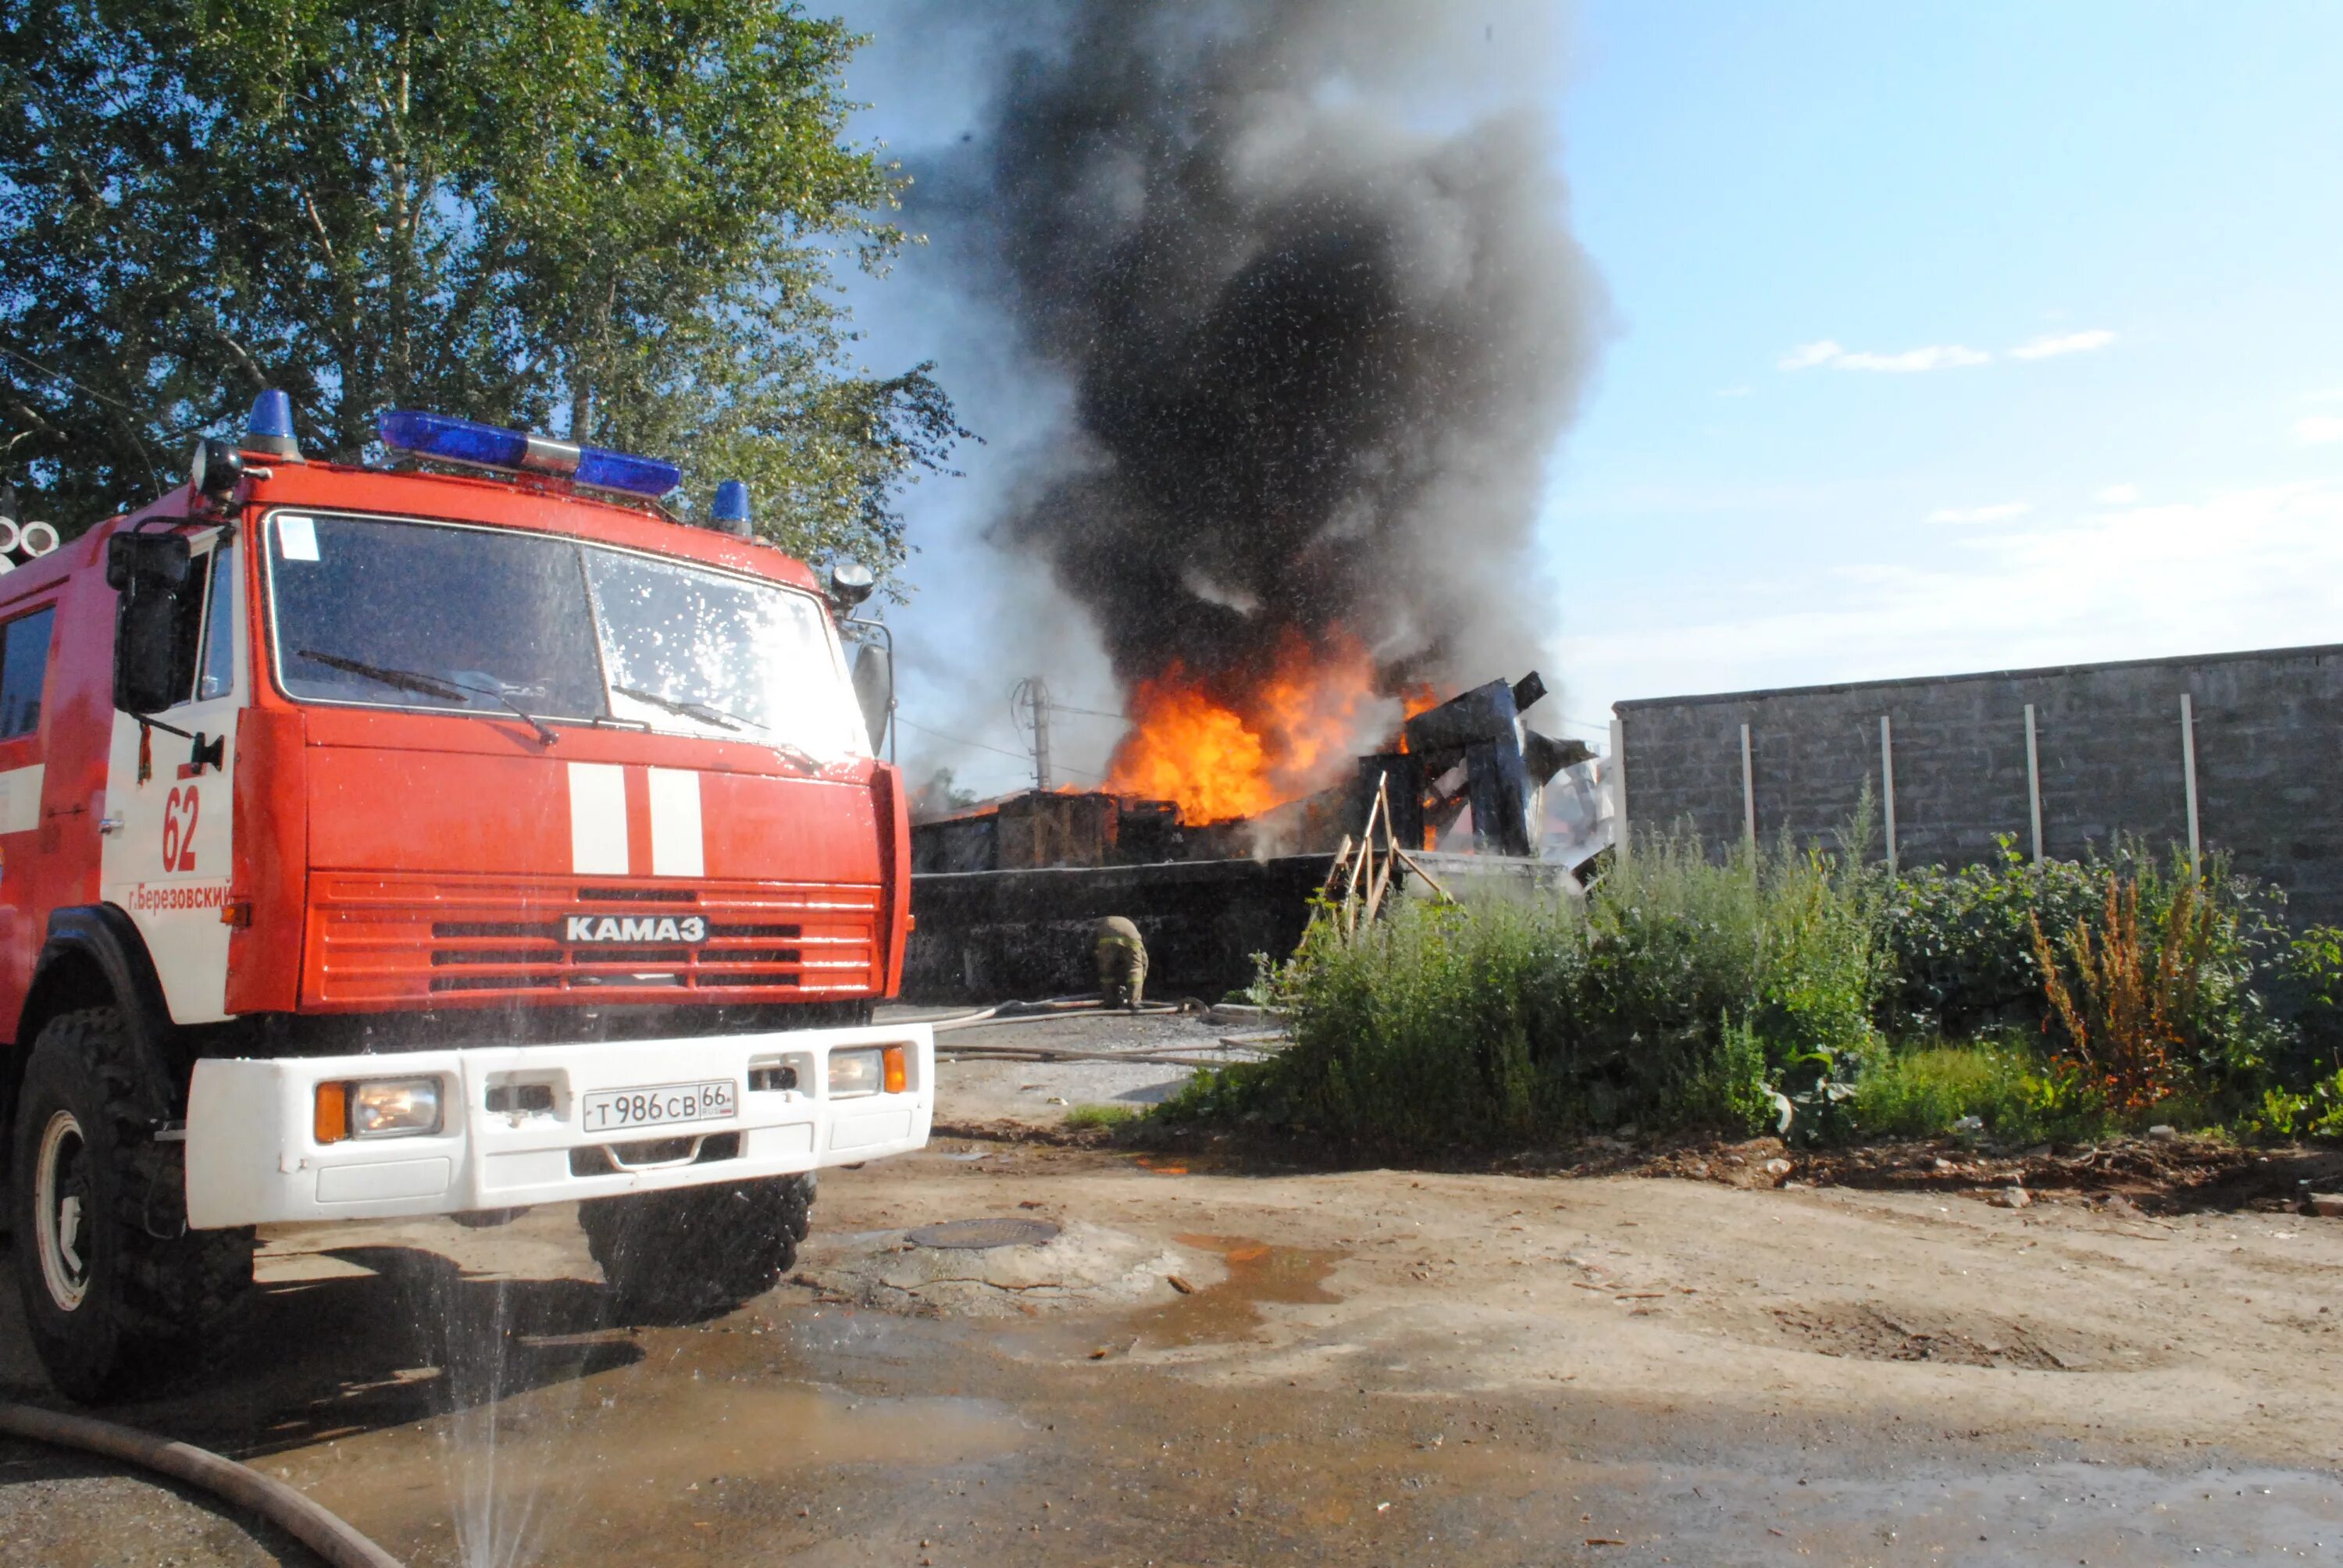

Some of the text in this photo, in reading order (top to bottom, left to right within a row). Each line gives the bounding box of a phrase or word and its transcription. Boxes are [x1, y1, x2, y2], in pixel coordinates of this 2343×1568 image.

[162, 785, 199, 872] 62
[129, 878, 232, 916] г.Березовский
[567, 916, 705, 943] КАМАЗ
[703, 1086, 726, 1107] 66
